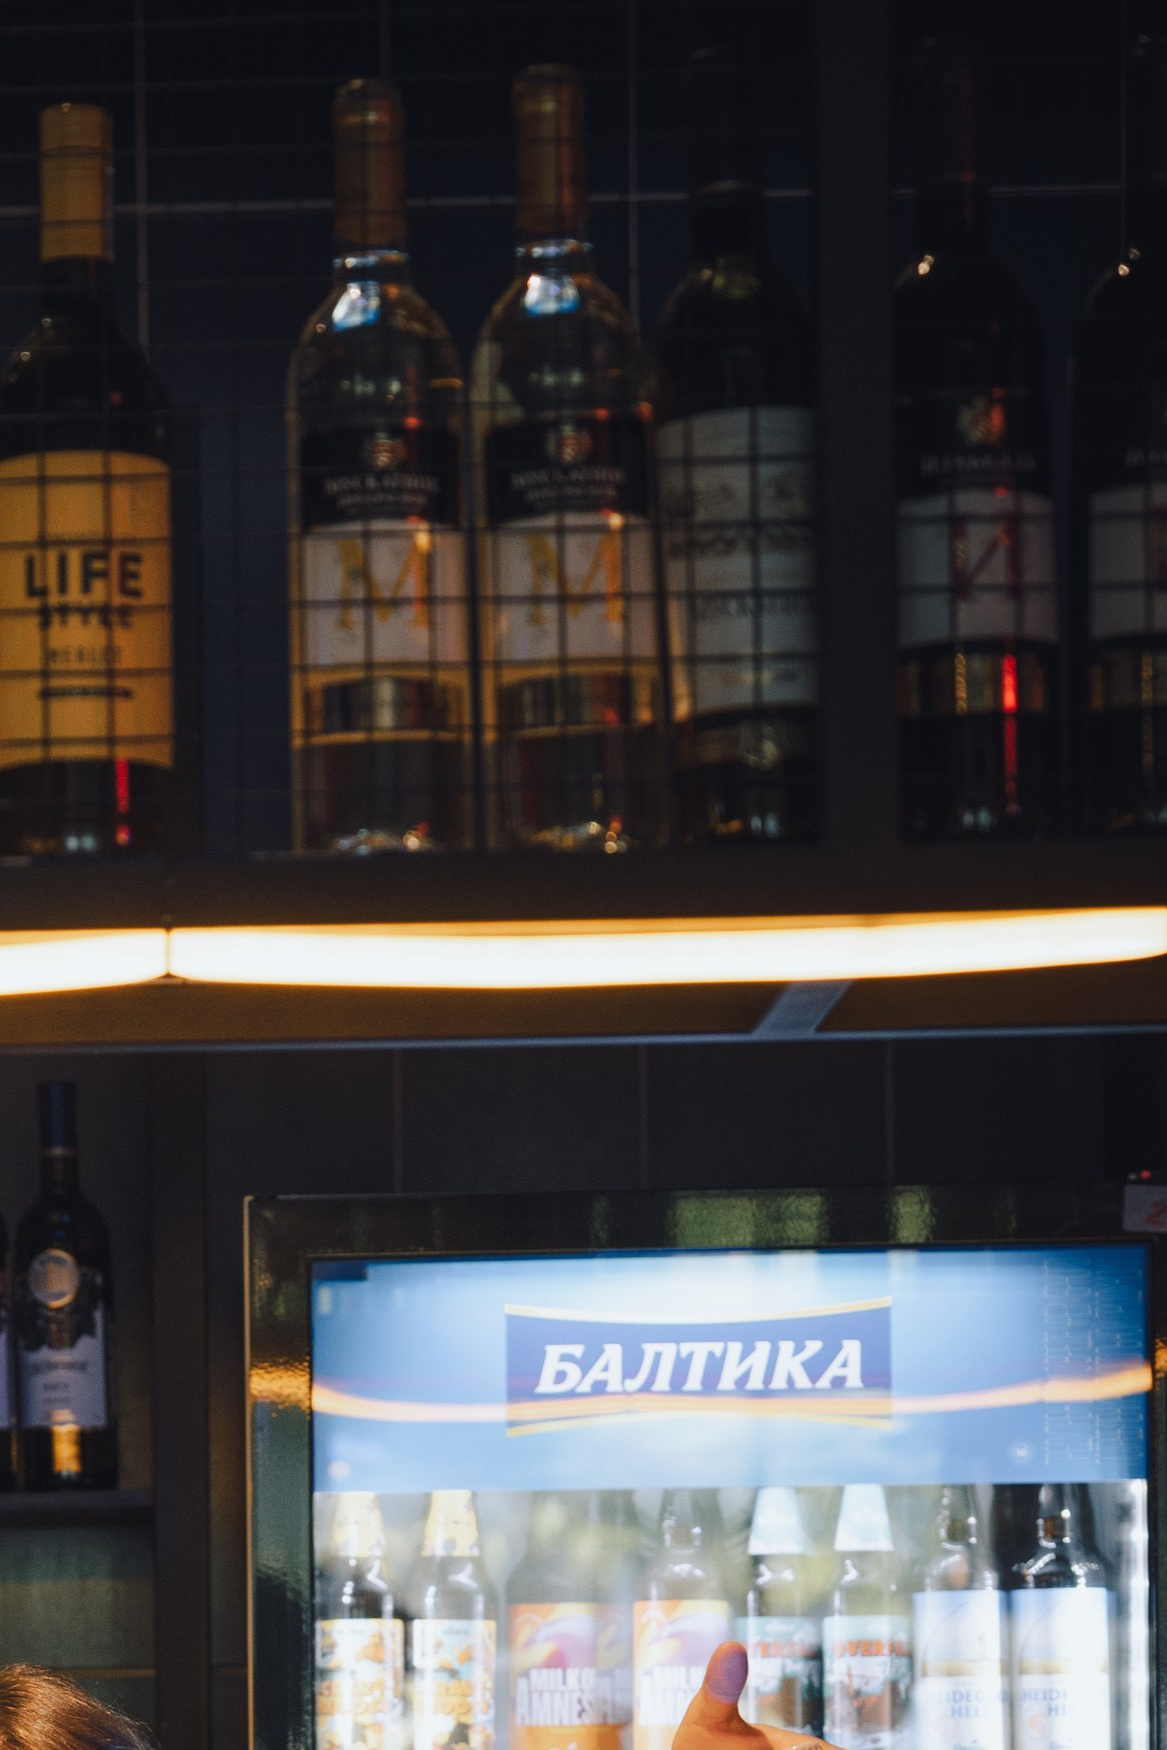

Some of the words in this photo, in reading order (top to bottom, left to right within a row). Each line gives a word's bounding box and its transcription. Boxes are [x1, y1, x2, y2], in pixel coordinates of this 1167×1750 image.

[25, 552, 142, 598] LIFE
[535, 1339, 864, 1394] БАЛТИКА
[516, 1677, 597, 1726] AMNES
